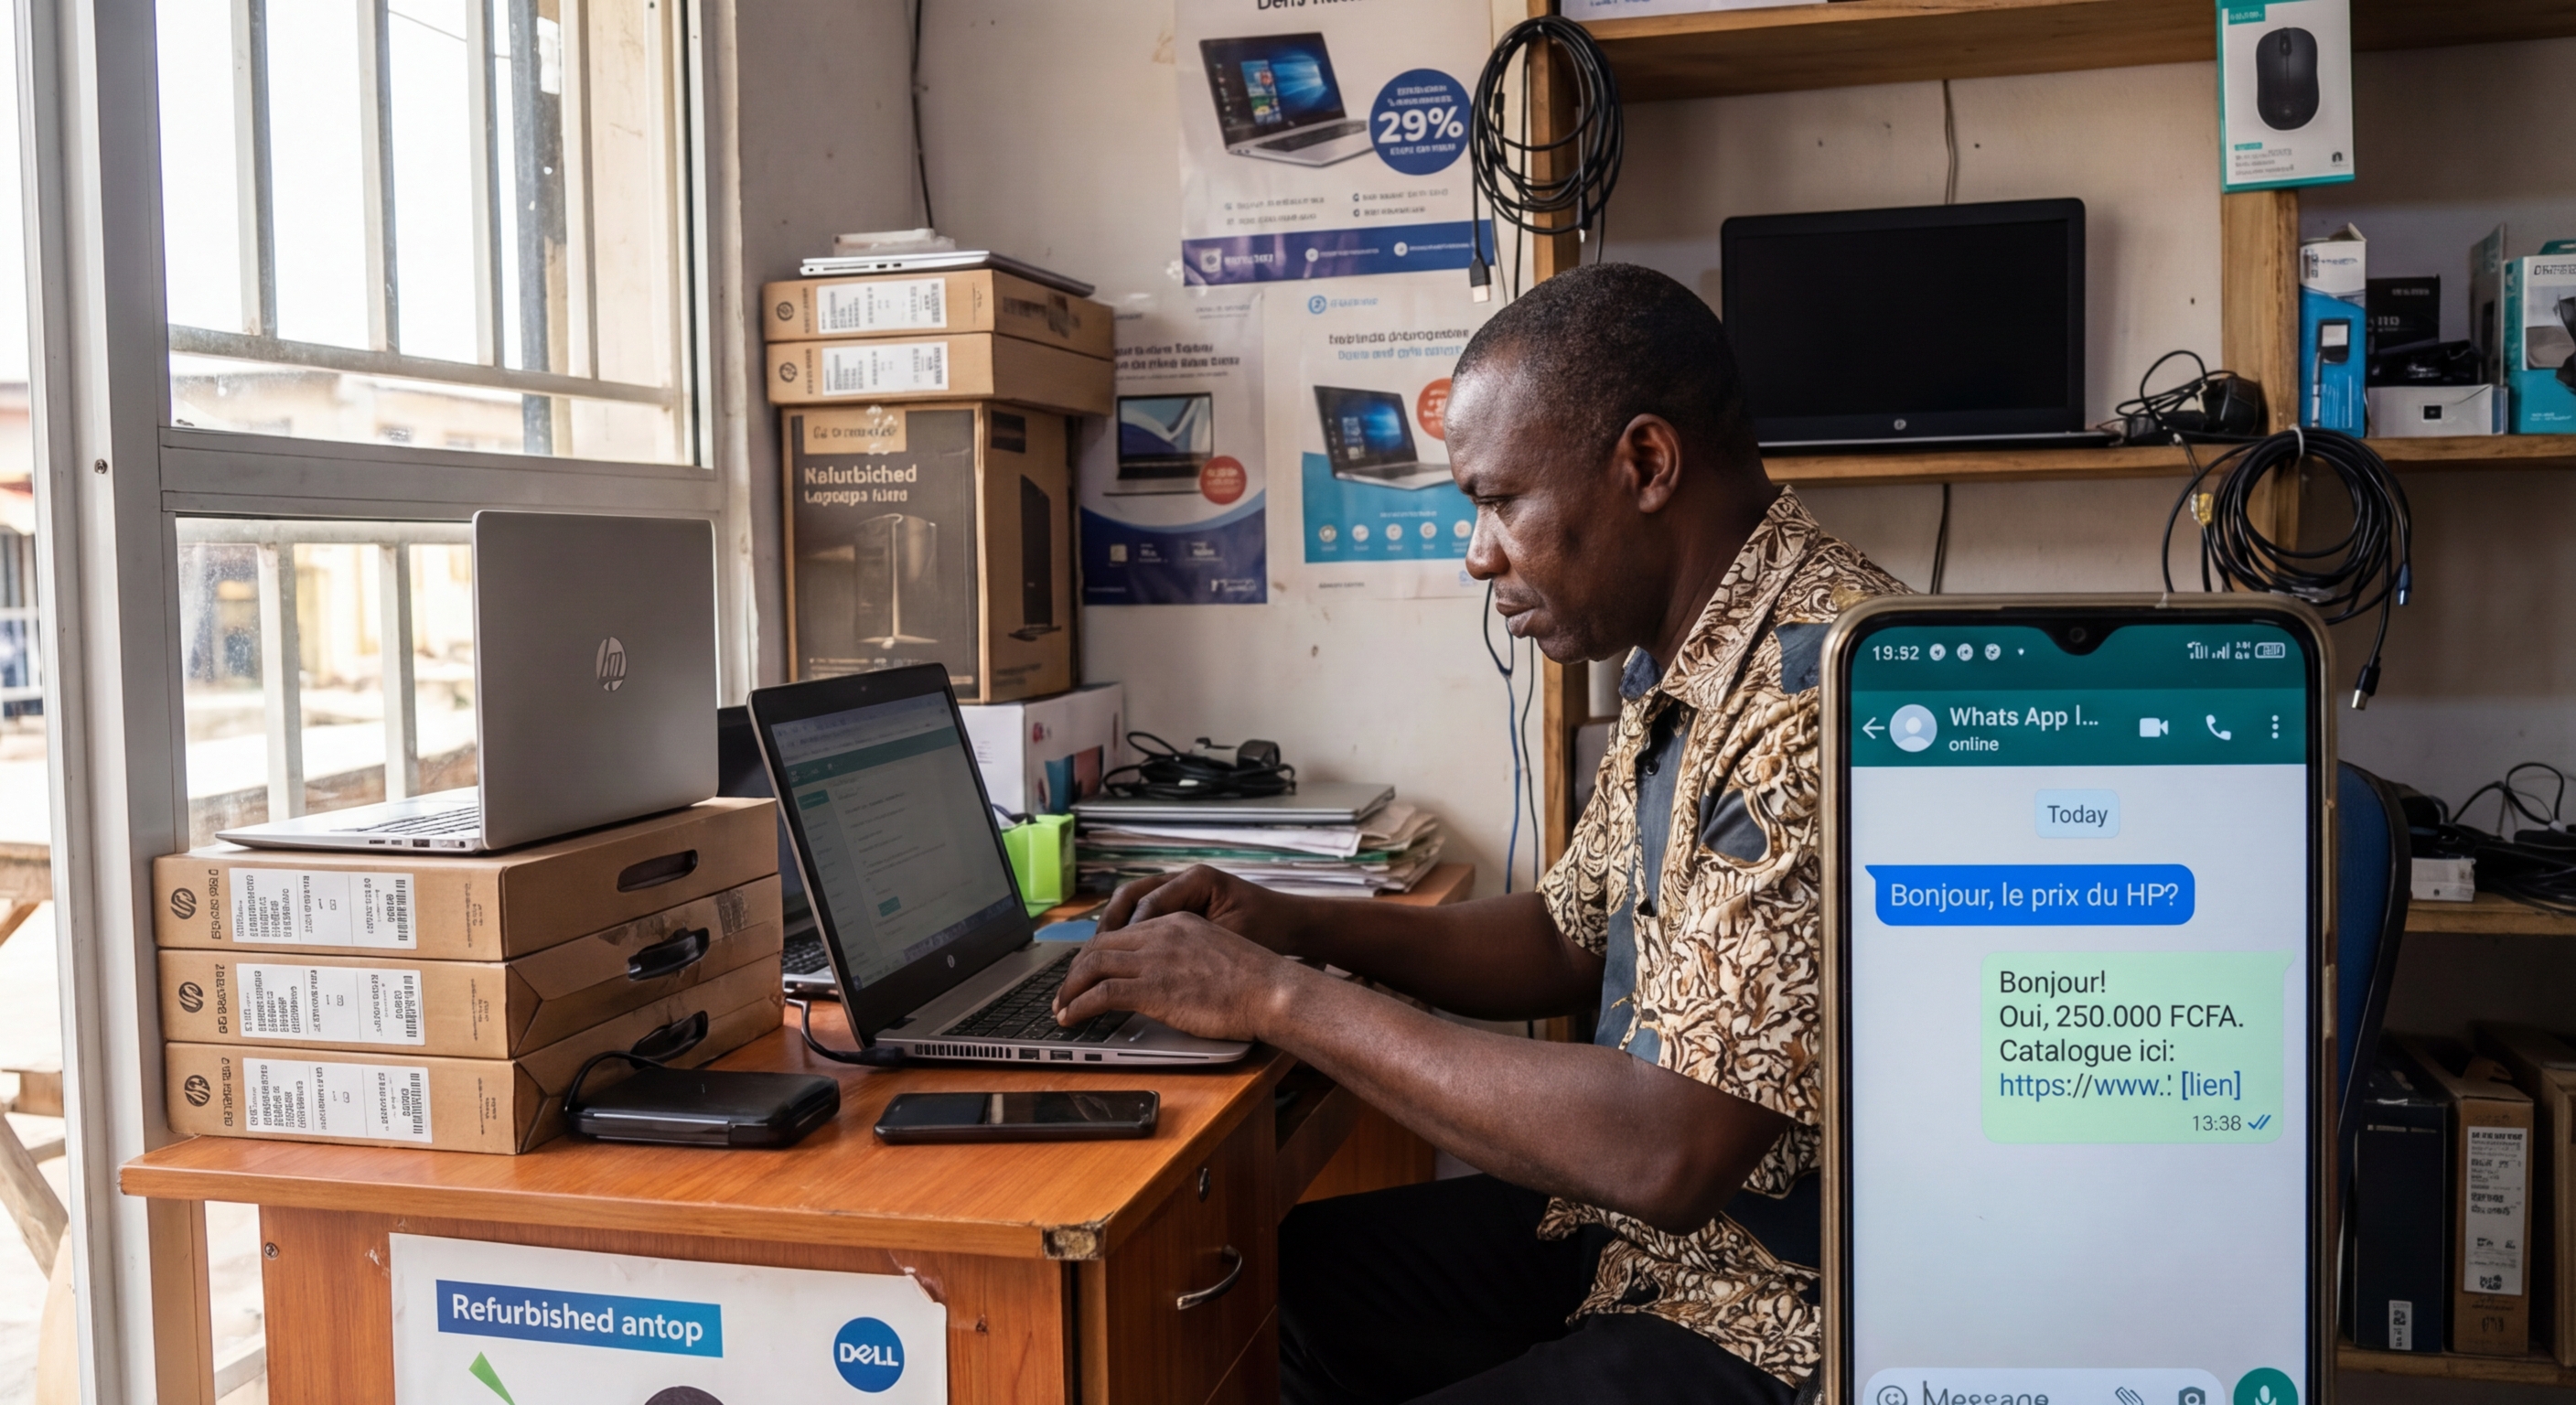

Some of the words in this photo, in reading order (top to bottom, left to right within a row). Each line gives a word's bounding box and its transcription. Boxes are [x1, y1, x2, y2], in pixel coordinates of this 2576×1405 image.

[1378, 105, 1464, 144] 29%
[1949, 705, 2019, 727] Whats
[2024, 706, 2068, 731] App
[1948, 736, 2000, 752] online
[2046, 804, 2109, 828] Today
[1891, 882, 1994, 913] Bonjour,
[2002, 881, 2024, 906] le
[2032, 883, 2079, 913] prix
[2087, 882, 2118, 906] du
[2127, 883, 2179, 906] HP?
[2000, 970, 2106, 999] Bonjour!
[1999, 1003, 2049, 1031] Oui,
[2055, 1004, 2162, 1028] 250.000
[2171, 1004, 2245, 1028] FCFA.
[2000, 1038, 2131, 1067] Catalogue
[2140, 1038, 2175, 1062] ici:
[2181, 1070, 2241, 1101] [lien]
[2192, 1114, 2242, 1132] 13:38
[452, 1292, 614, 1334] Refurbished
[621, 1314, 703, 1347] antop
